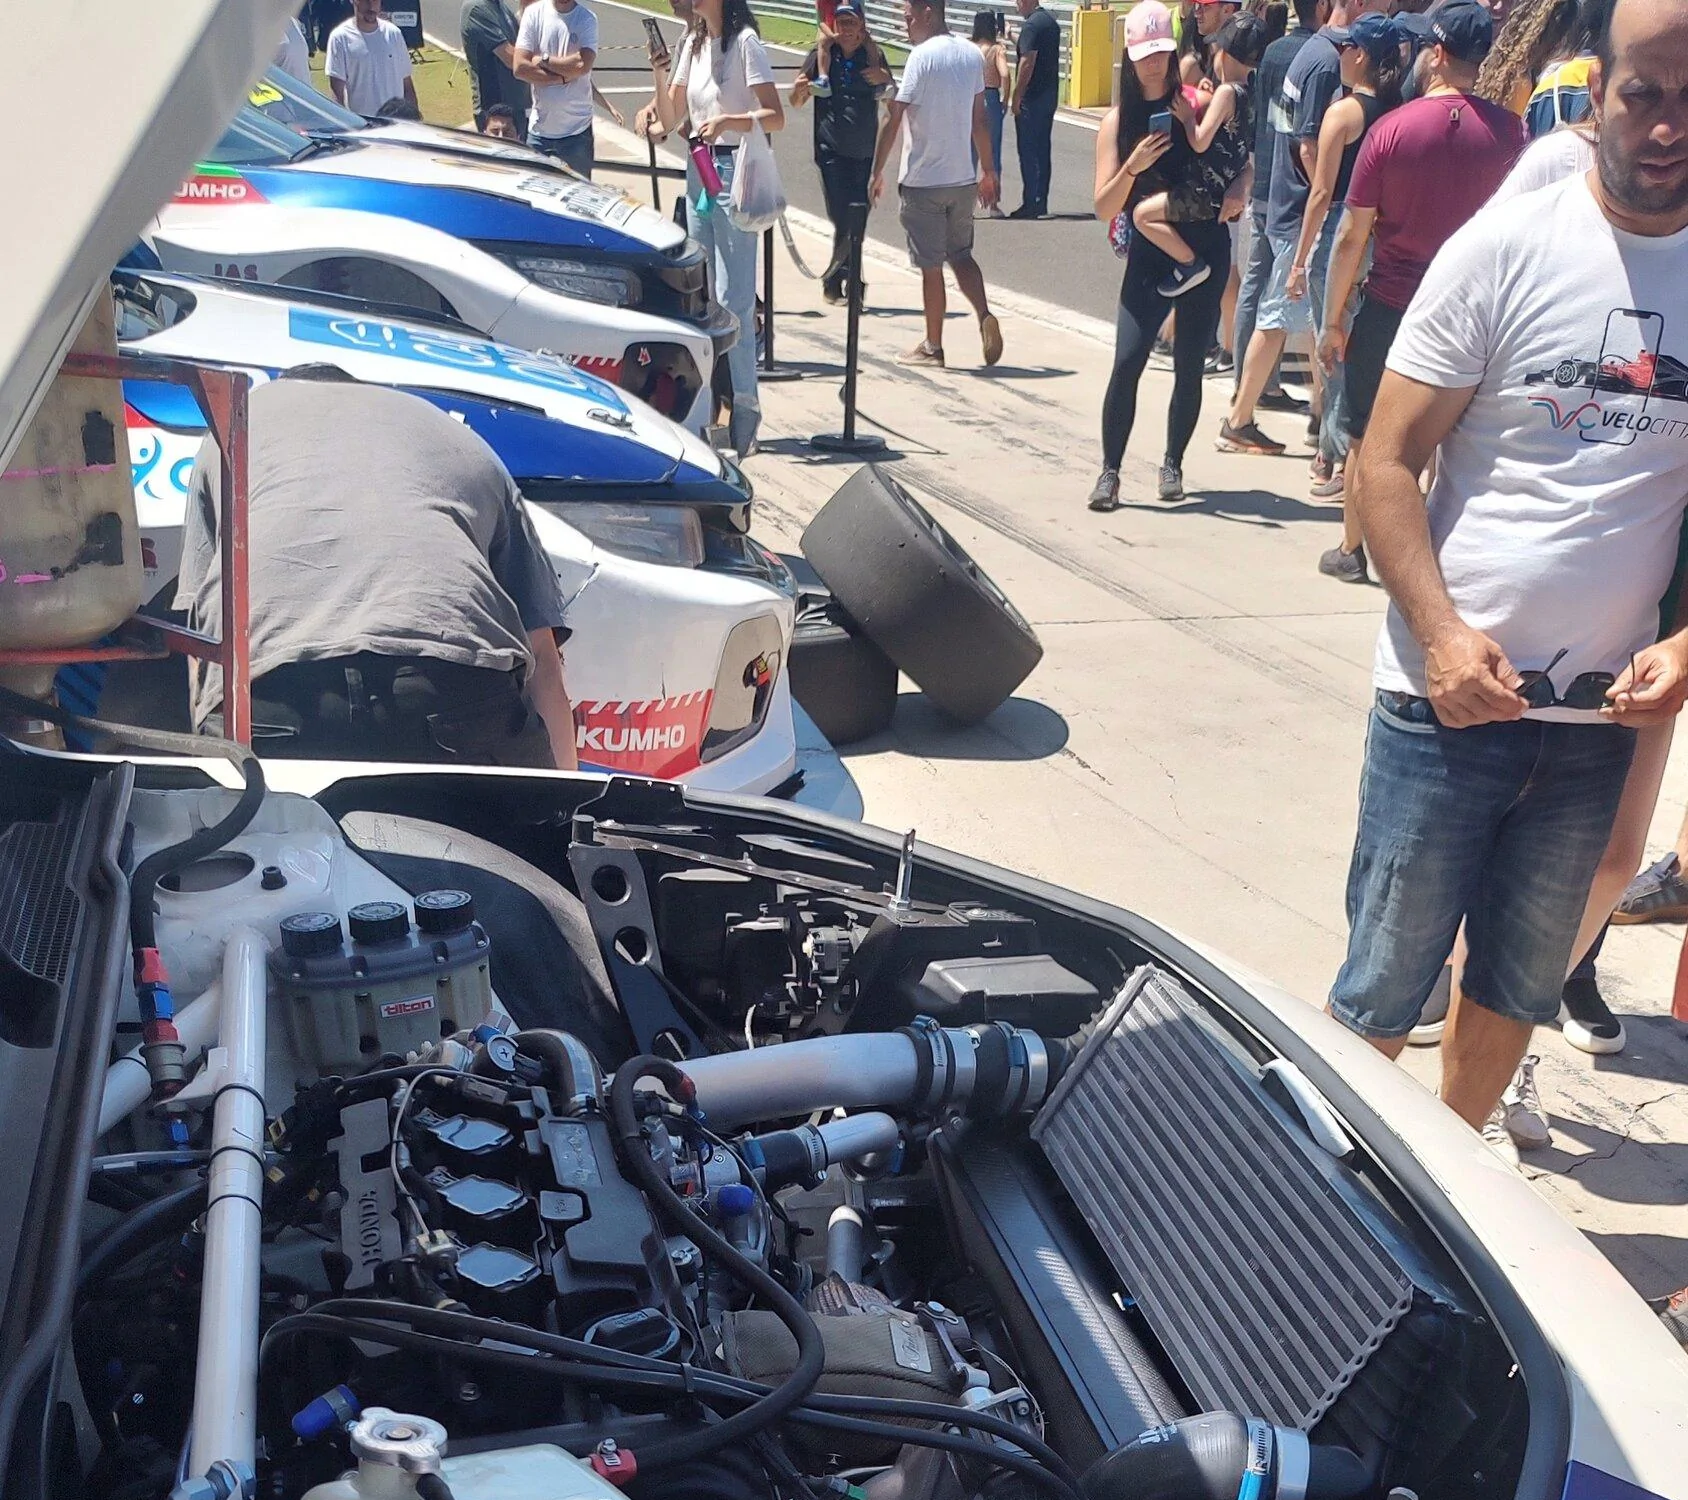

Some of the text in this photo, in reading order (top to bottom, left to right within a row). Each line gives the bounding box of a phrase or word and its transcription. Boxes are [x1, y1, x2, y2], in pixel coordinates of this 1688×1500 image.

[1602, 410, 1688, 440] VELOCITT
[576, 724, 686, 752] KUMHO
[384, 1000, 432, 1015] tilton
[359, 1190, 383, 1266] HONDA
